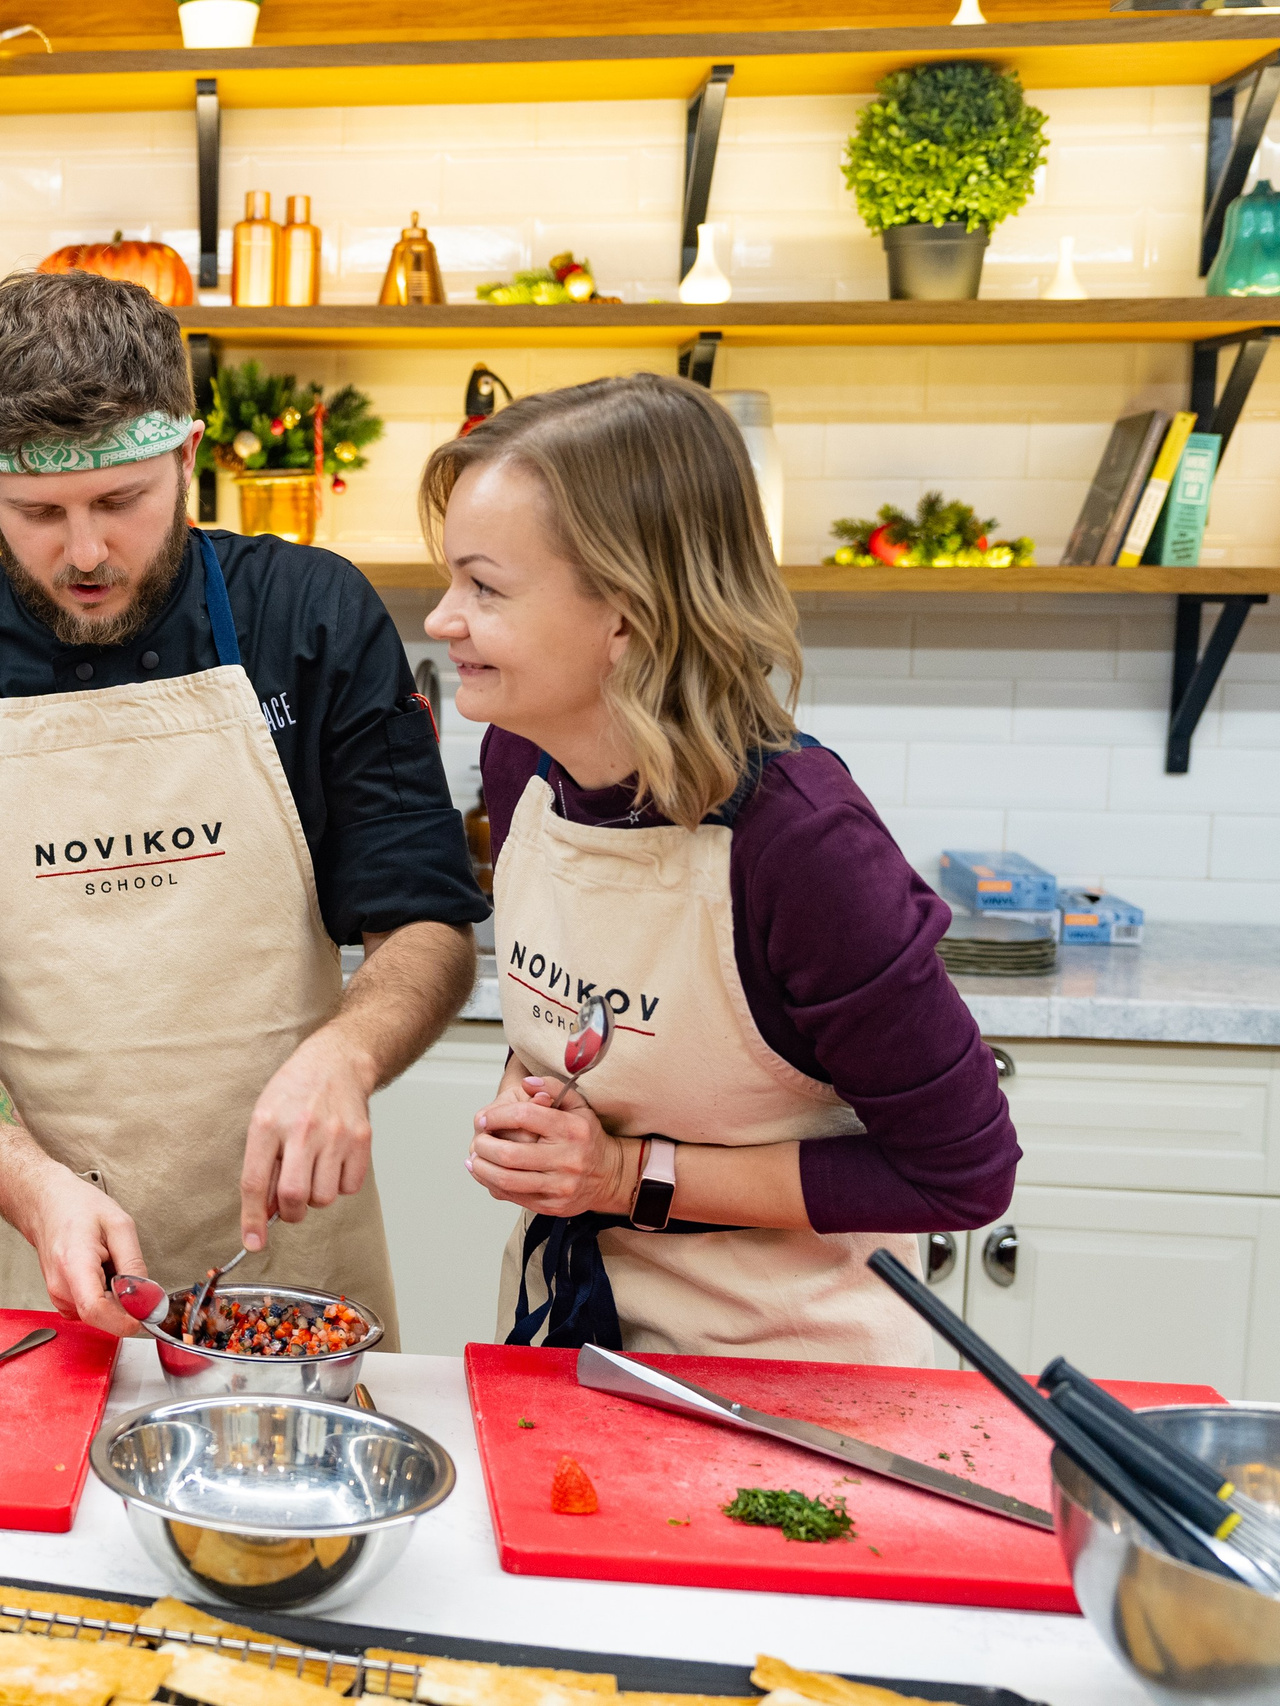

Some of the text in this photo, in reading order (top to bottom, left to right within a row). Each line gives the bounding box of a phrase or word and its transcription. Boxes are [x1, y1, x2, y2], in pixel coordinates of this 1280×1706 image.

[35, 822, 222, 866] NOVIKOV
[85, 873, 178, 895] SCHOOL
[510, 940, 659, 1021] NOVIKOV
